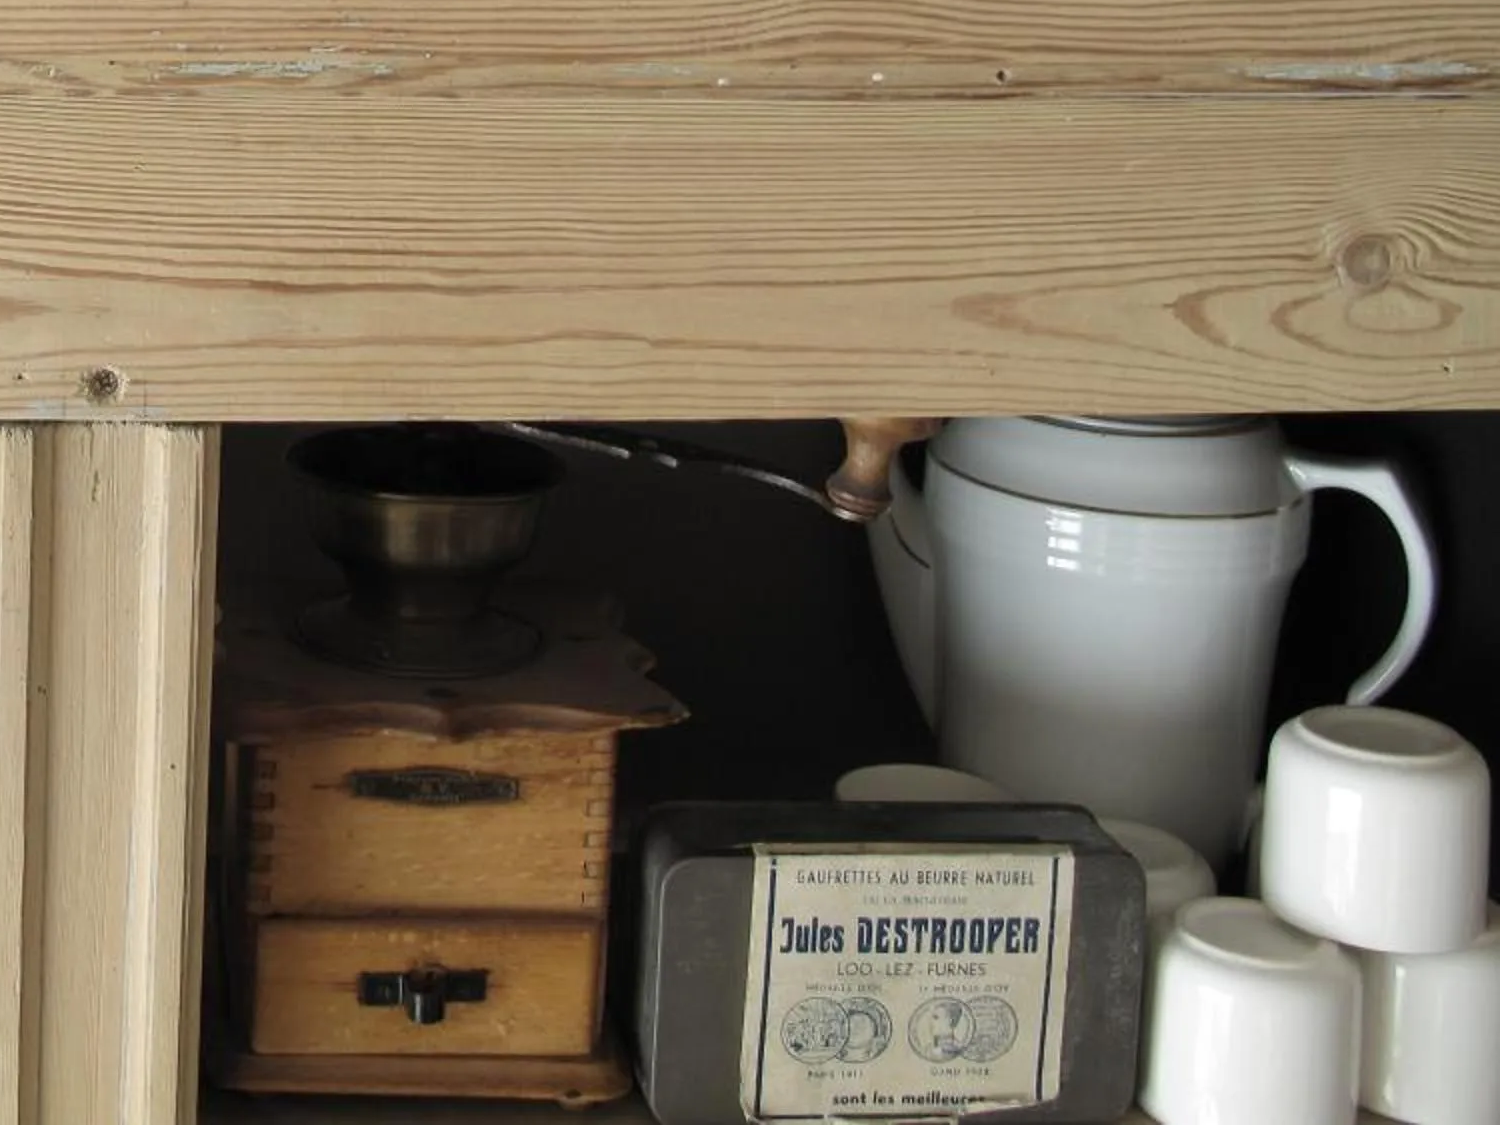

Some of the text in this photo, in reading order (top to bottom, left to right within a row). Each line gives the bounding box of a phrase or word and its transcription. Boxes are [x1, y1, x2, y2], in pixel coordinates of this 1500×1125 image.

[796, 868, 1035, 887] GAUFRETTES AU BEURRE NATUREL
[779, 916, 1041, 954] Jules DESTROOPER
[837, 961, 988, 977] LOO LEZ FURNES
[832, 1092, 867, 1105] sont
[872, 1091, 895, 1105] les
